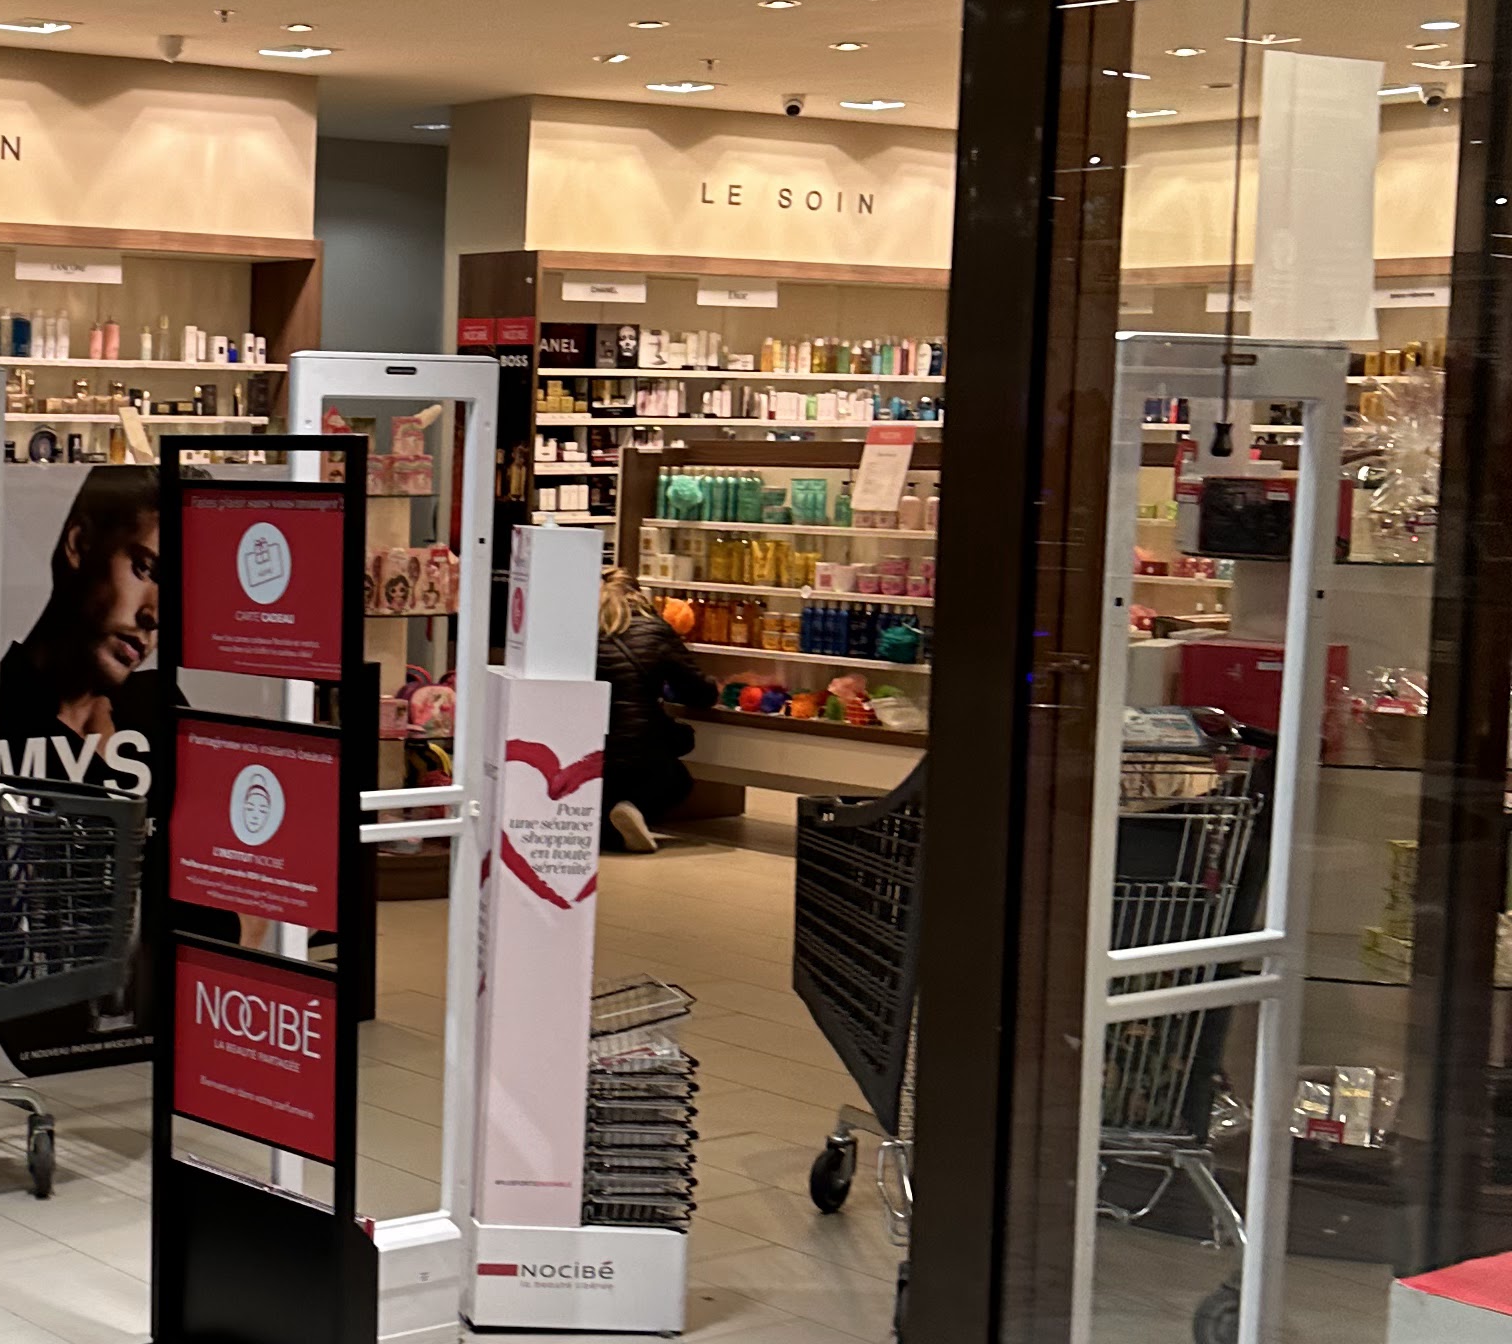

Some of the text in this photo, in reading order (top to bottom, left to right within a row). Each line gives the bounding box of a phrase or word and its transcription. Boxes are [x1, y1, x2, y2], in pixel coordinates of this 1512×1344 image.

[701, 182, 875, 215] LE SOIN
[500, 354, 529, 368] BOSS
[557, 803, 594, 817] Pour
[540, 817, 594, 831] séance
[521, 831, 592, 850] shopping
[530, 849, 550, 860] en
[196, 981, 322, 1060] NOCIBÉ
